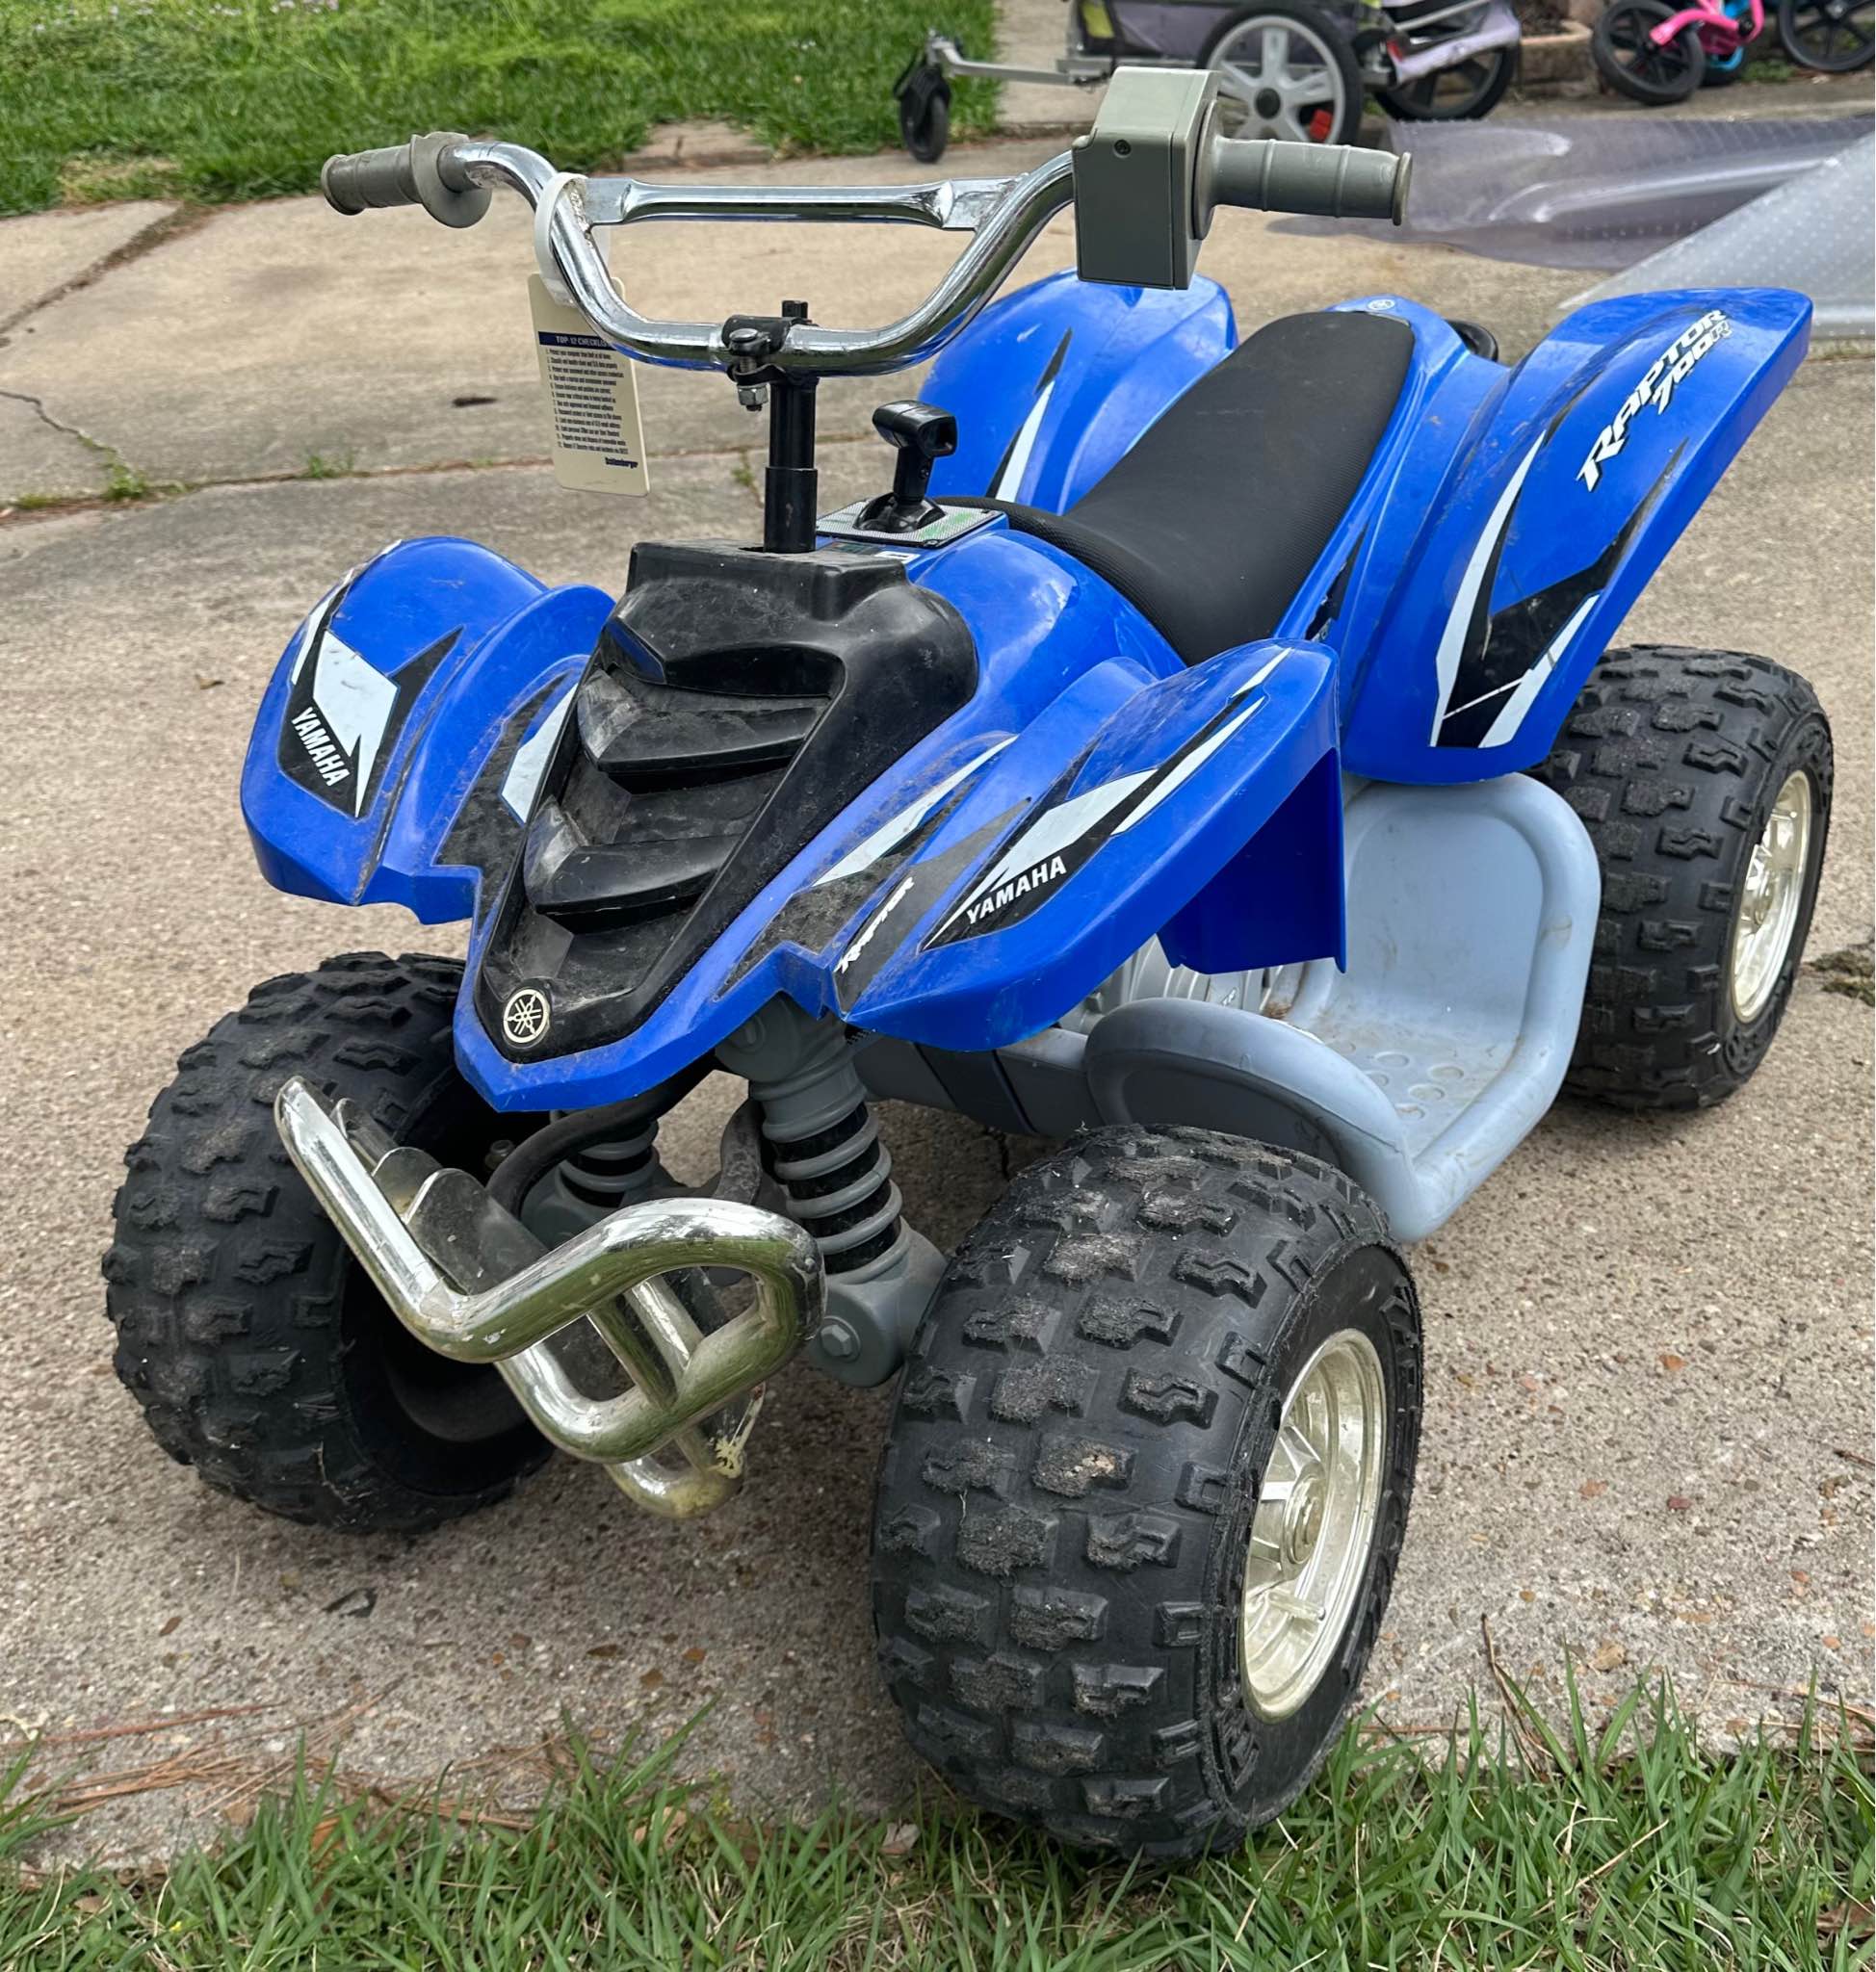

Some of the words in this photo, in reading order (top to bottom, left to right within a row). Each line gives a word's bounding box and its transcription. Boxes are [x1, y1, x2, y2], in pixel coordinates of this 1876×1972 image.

[578, 337, 609, 348] CHECKLIS
[1653, 321, 1733, 415] 700R
[1576, 309, 1728, 492] RAPTOR
[291, 707, 351, 787] YAMAHA
[966, 855, 1067, 924] YAMAHA
